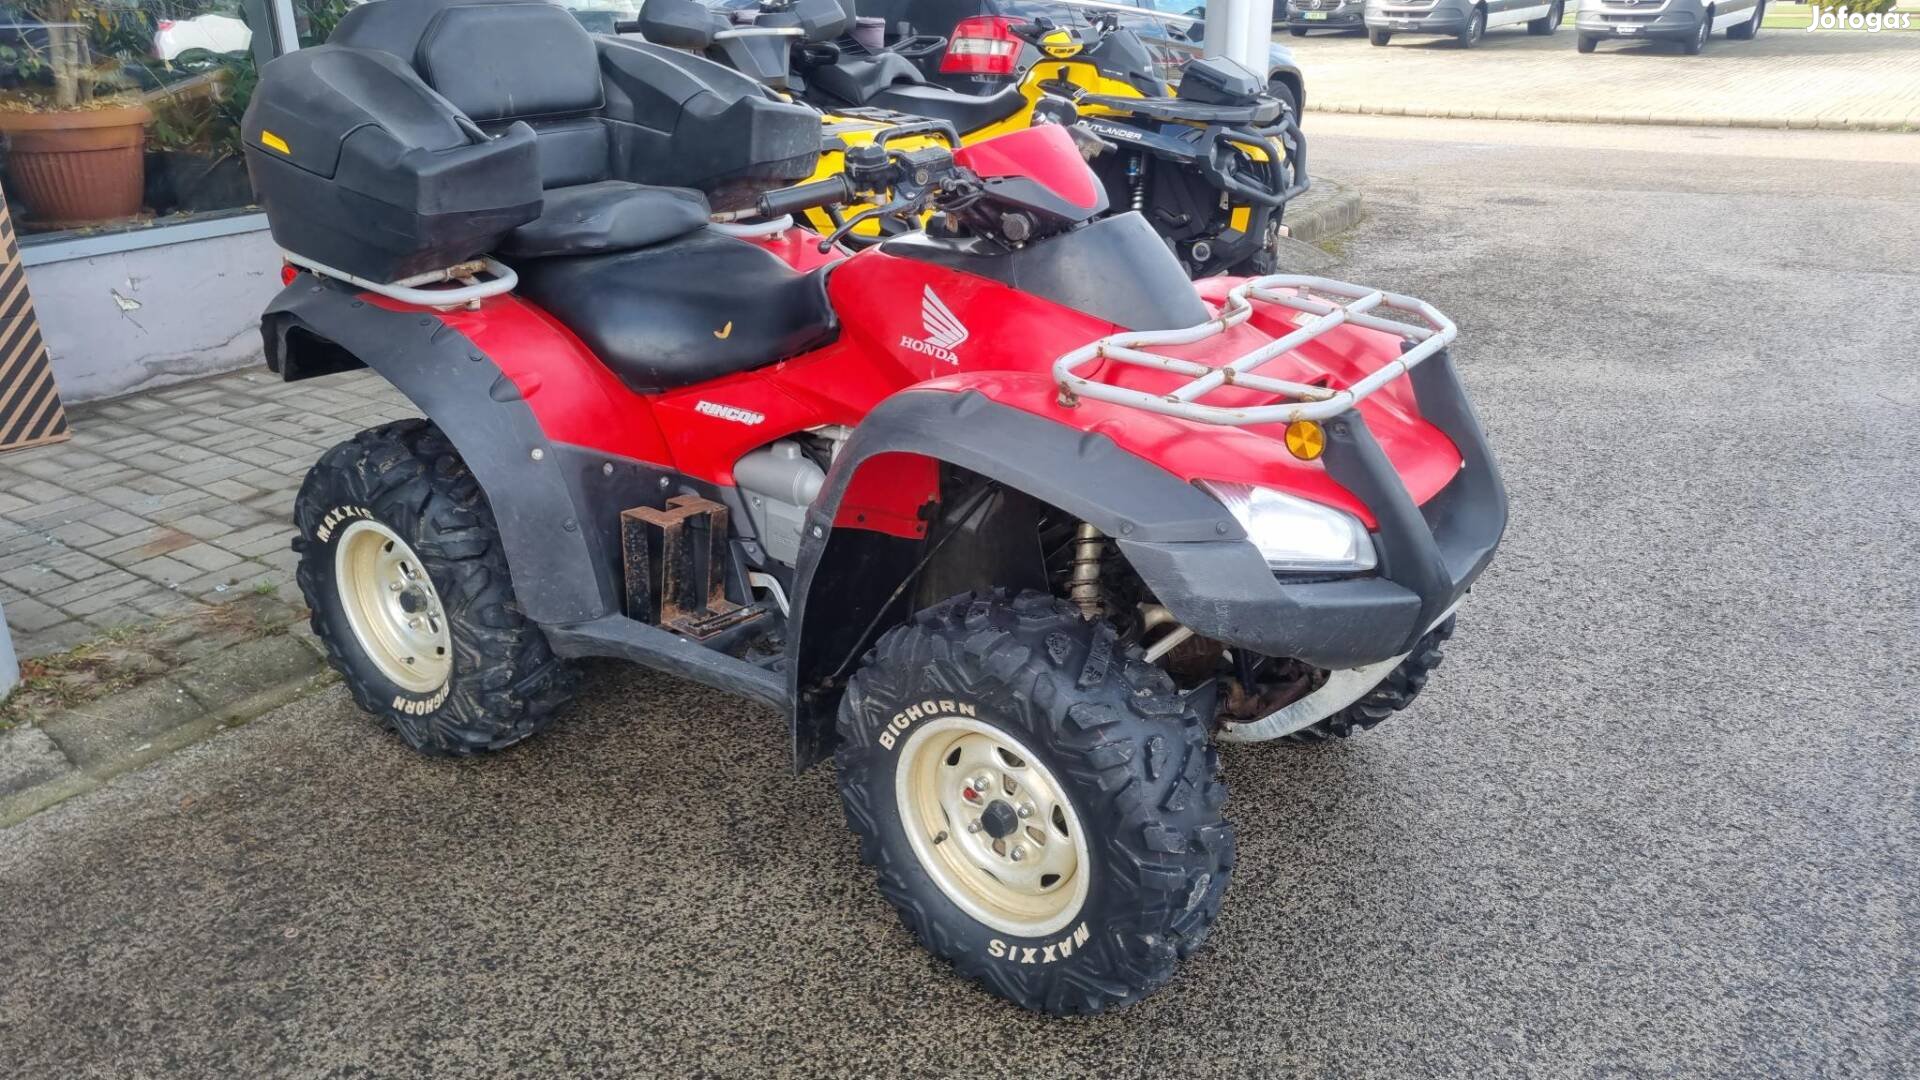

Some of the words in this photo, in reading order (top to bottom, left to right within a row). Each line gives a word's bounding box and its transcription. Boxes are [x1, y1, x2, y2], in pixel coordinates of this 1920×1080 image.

[900, 335, 959, 366] HONDA
[316, 505, 375, 543] MAXXIS
[392, 680, 450, 716] BIGHORN
[879, 700, 976, 751] BIGHORN
[987, 921, 1090, 964] MAXXIS
